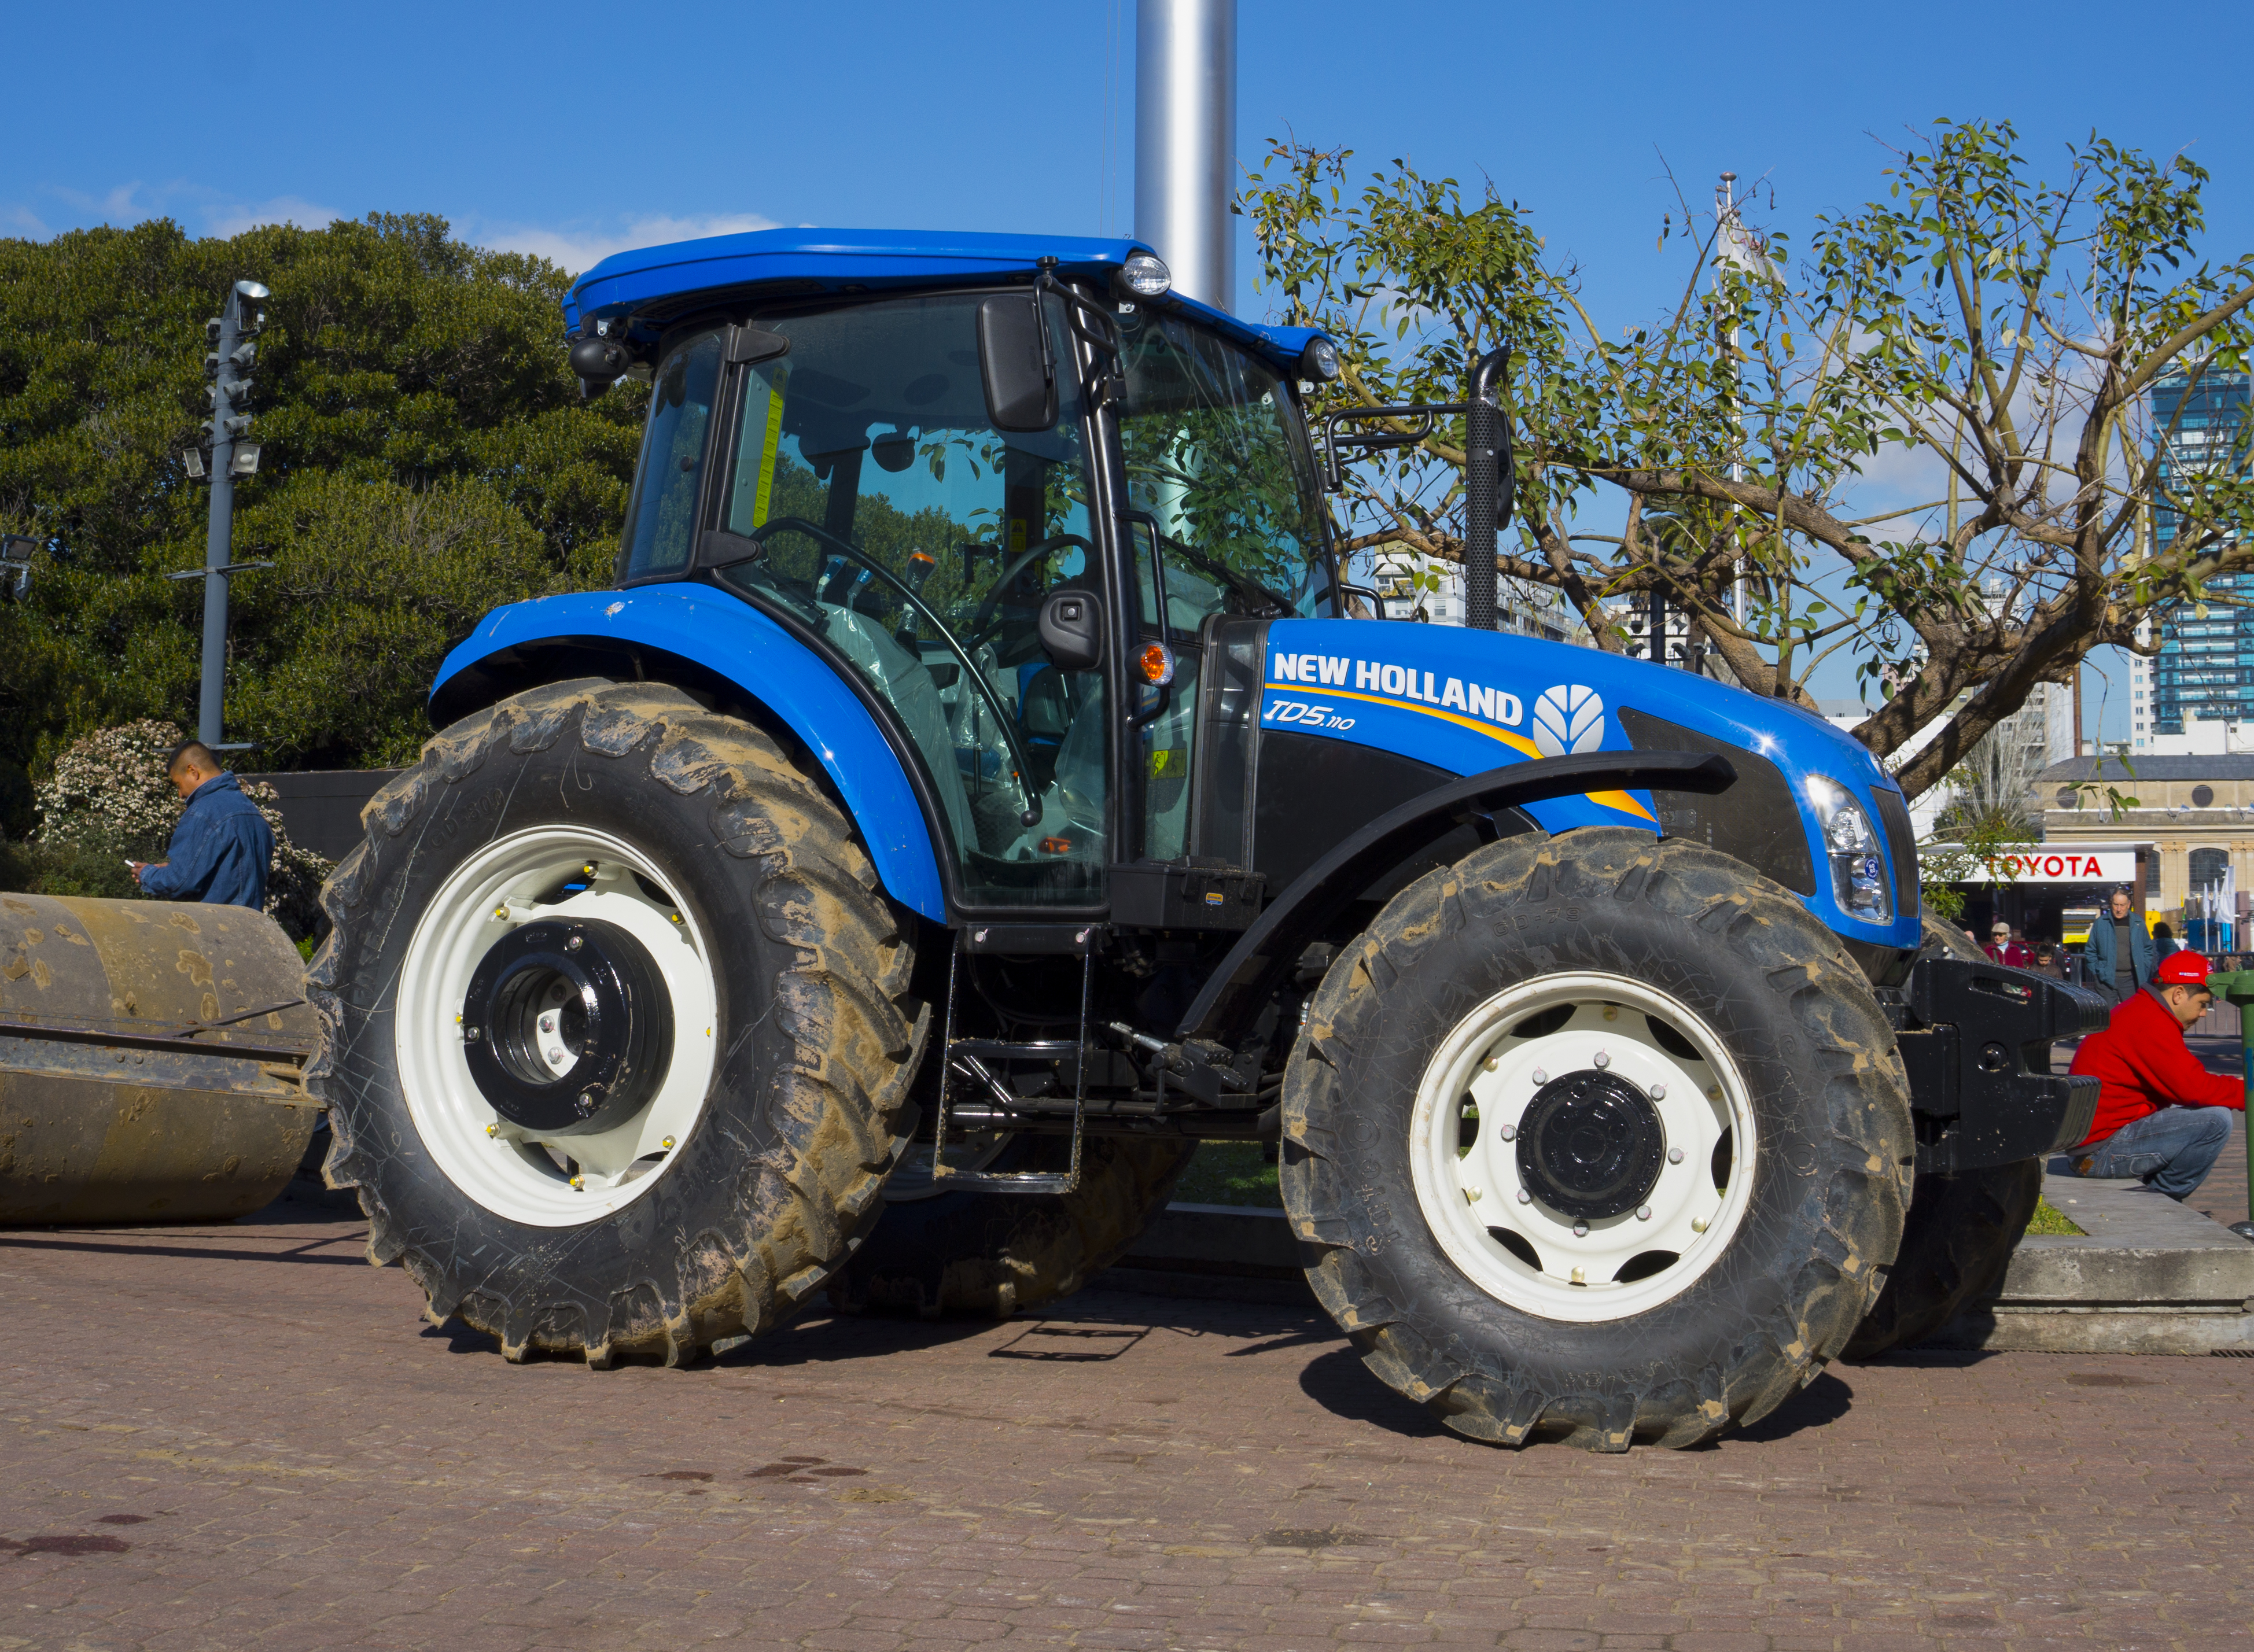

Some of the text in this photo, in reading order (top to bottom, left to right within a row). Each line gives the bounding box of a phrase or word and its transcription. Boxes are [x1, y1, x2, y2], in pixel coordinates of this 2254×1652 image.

[1274, 652, 1523, 727] NEW HOLLAND
[428, 787, 506, 850] GD-800
[1984, 856, 2103, 877] TOYOTA
[1493, 906, 1581, 937] GD-79
